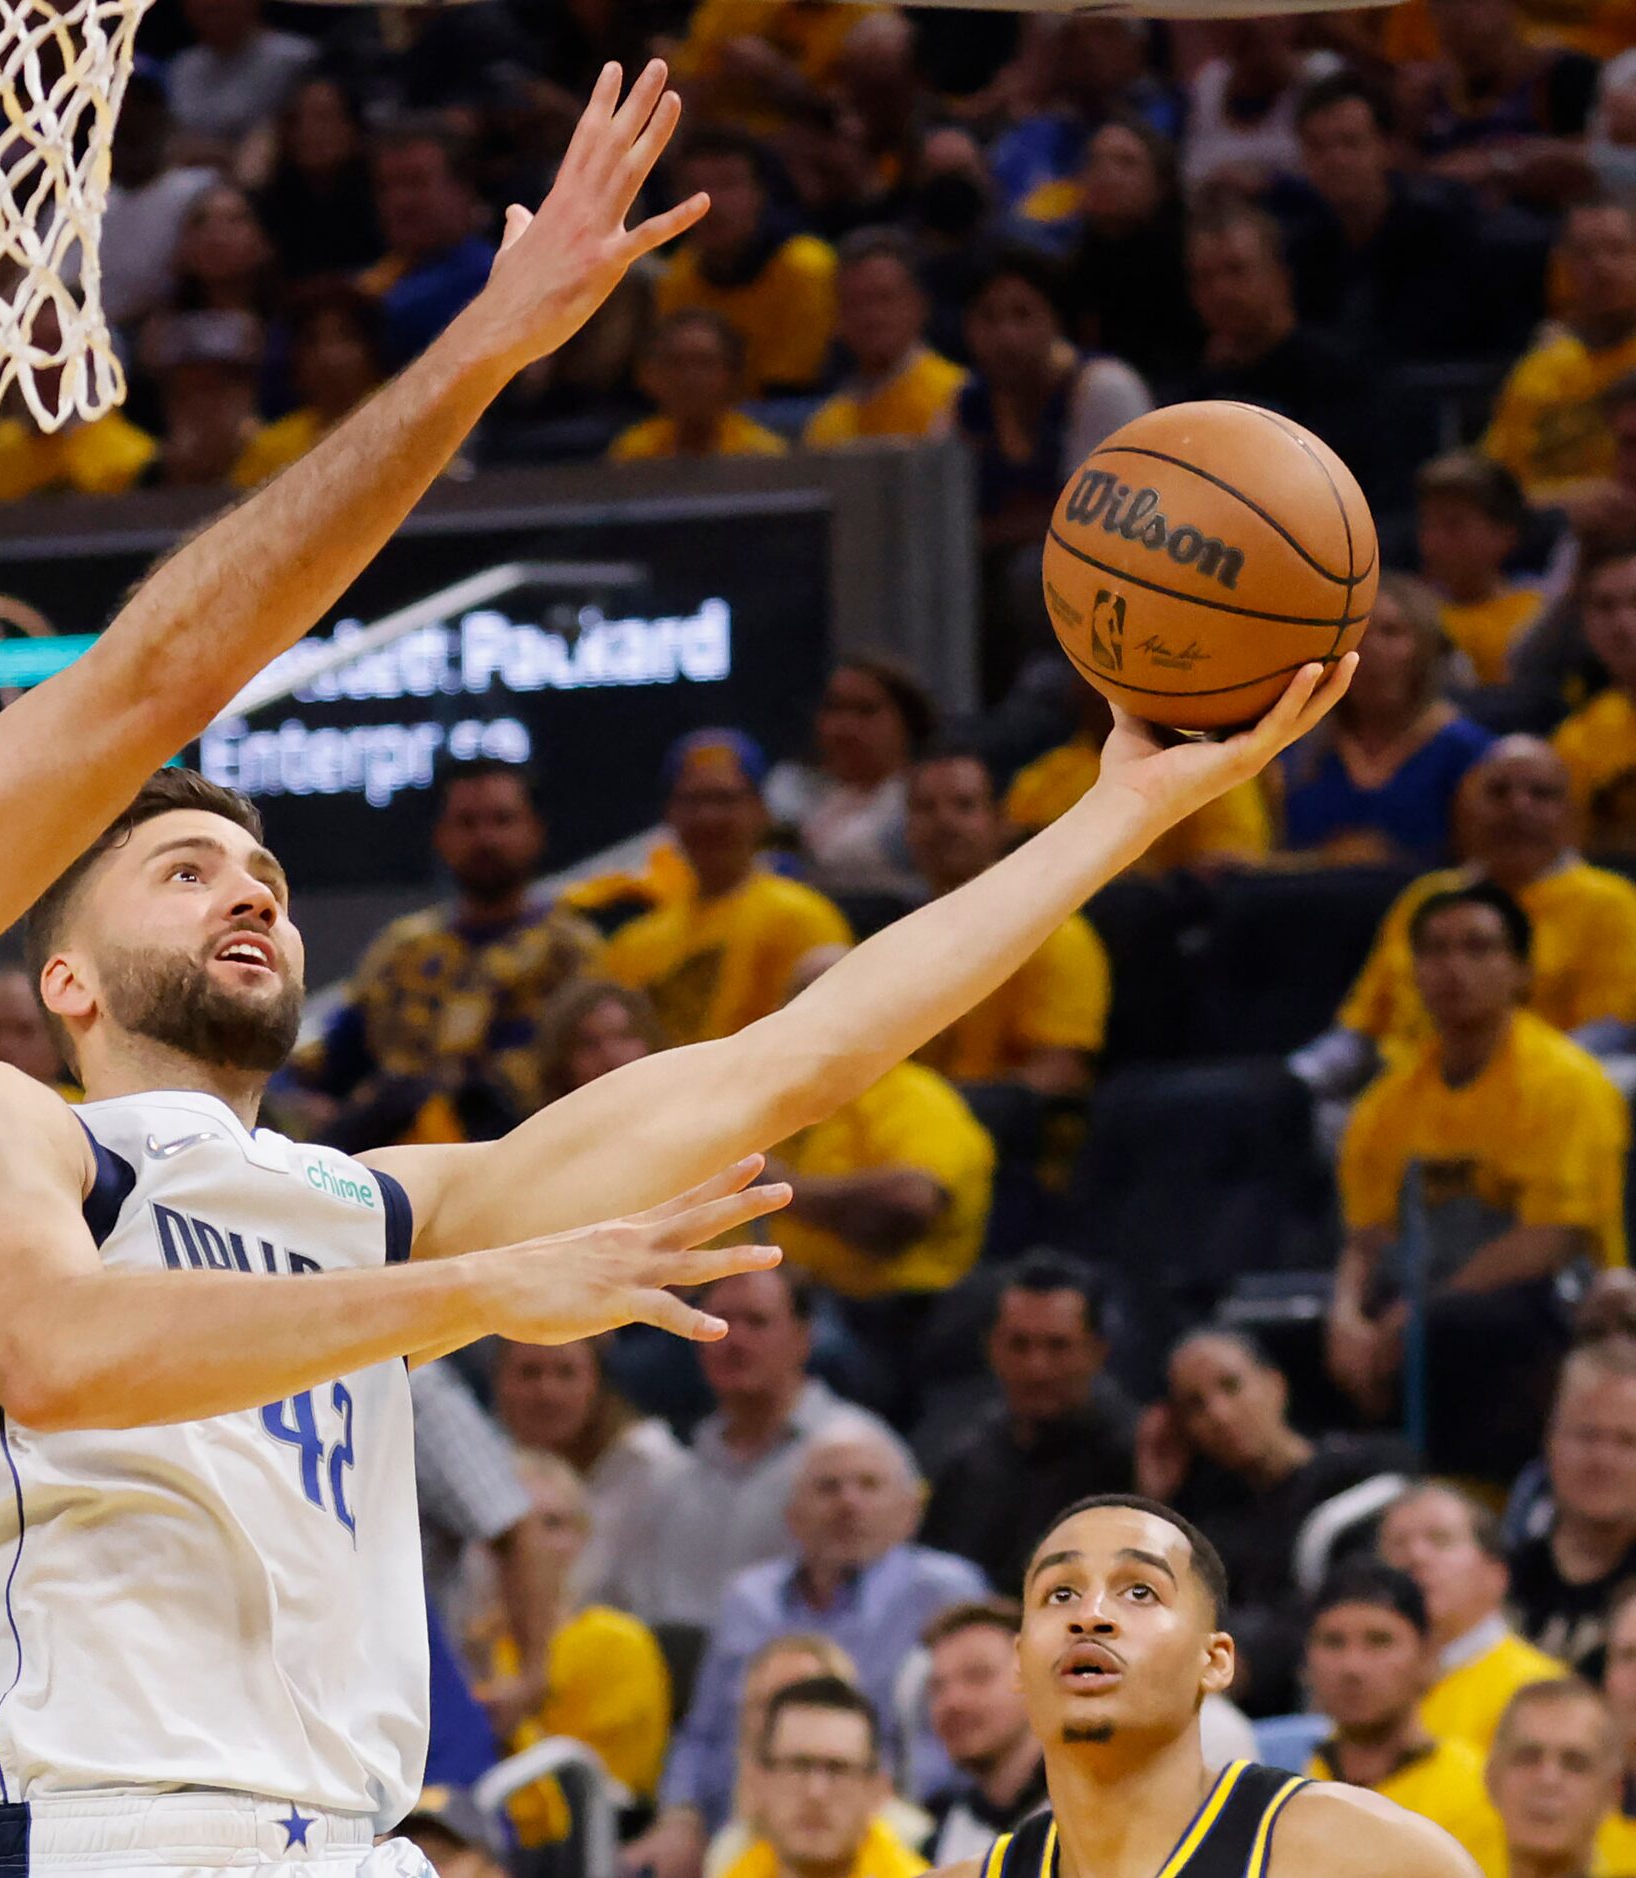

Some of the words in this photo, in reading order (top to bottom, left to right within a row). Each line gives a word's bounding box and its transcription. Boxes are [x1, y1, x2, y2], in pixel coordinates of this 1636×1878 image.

[1066, 470, 1245, 590] Wilson
[307, 1161, 375, 1208] chime
[259, 1380, 357, 1551] 42
